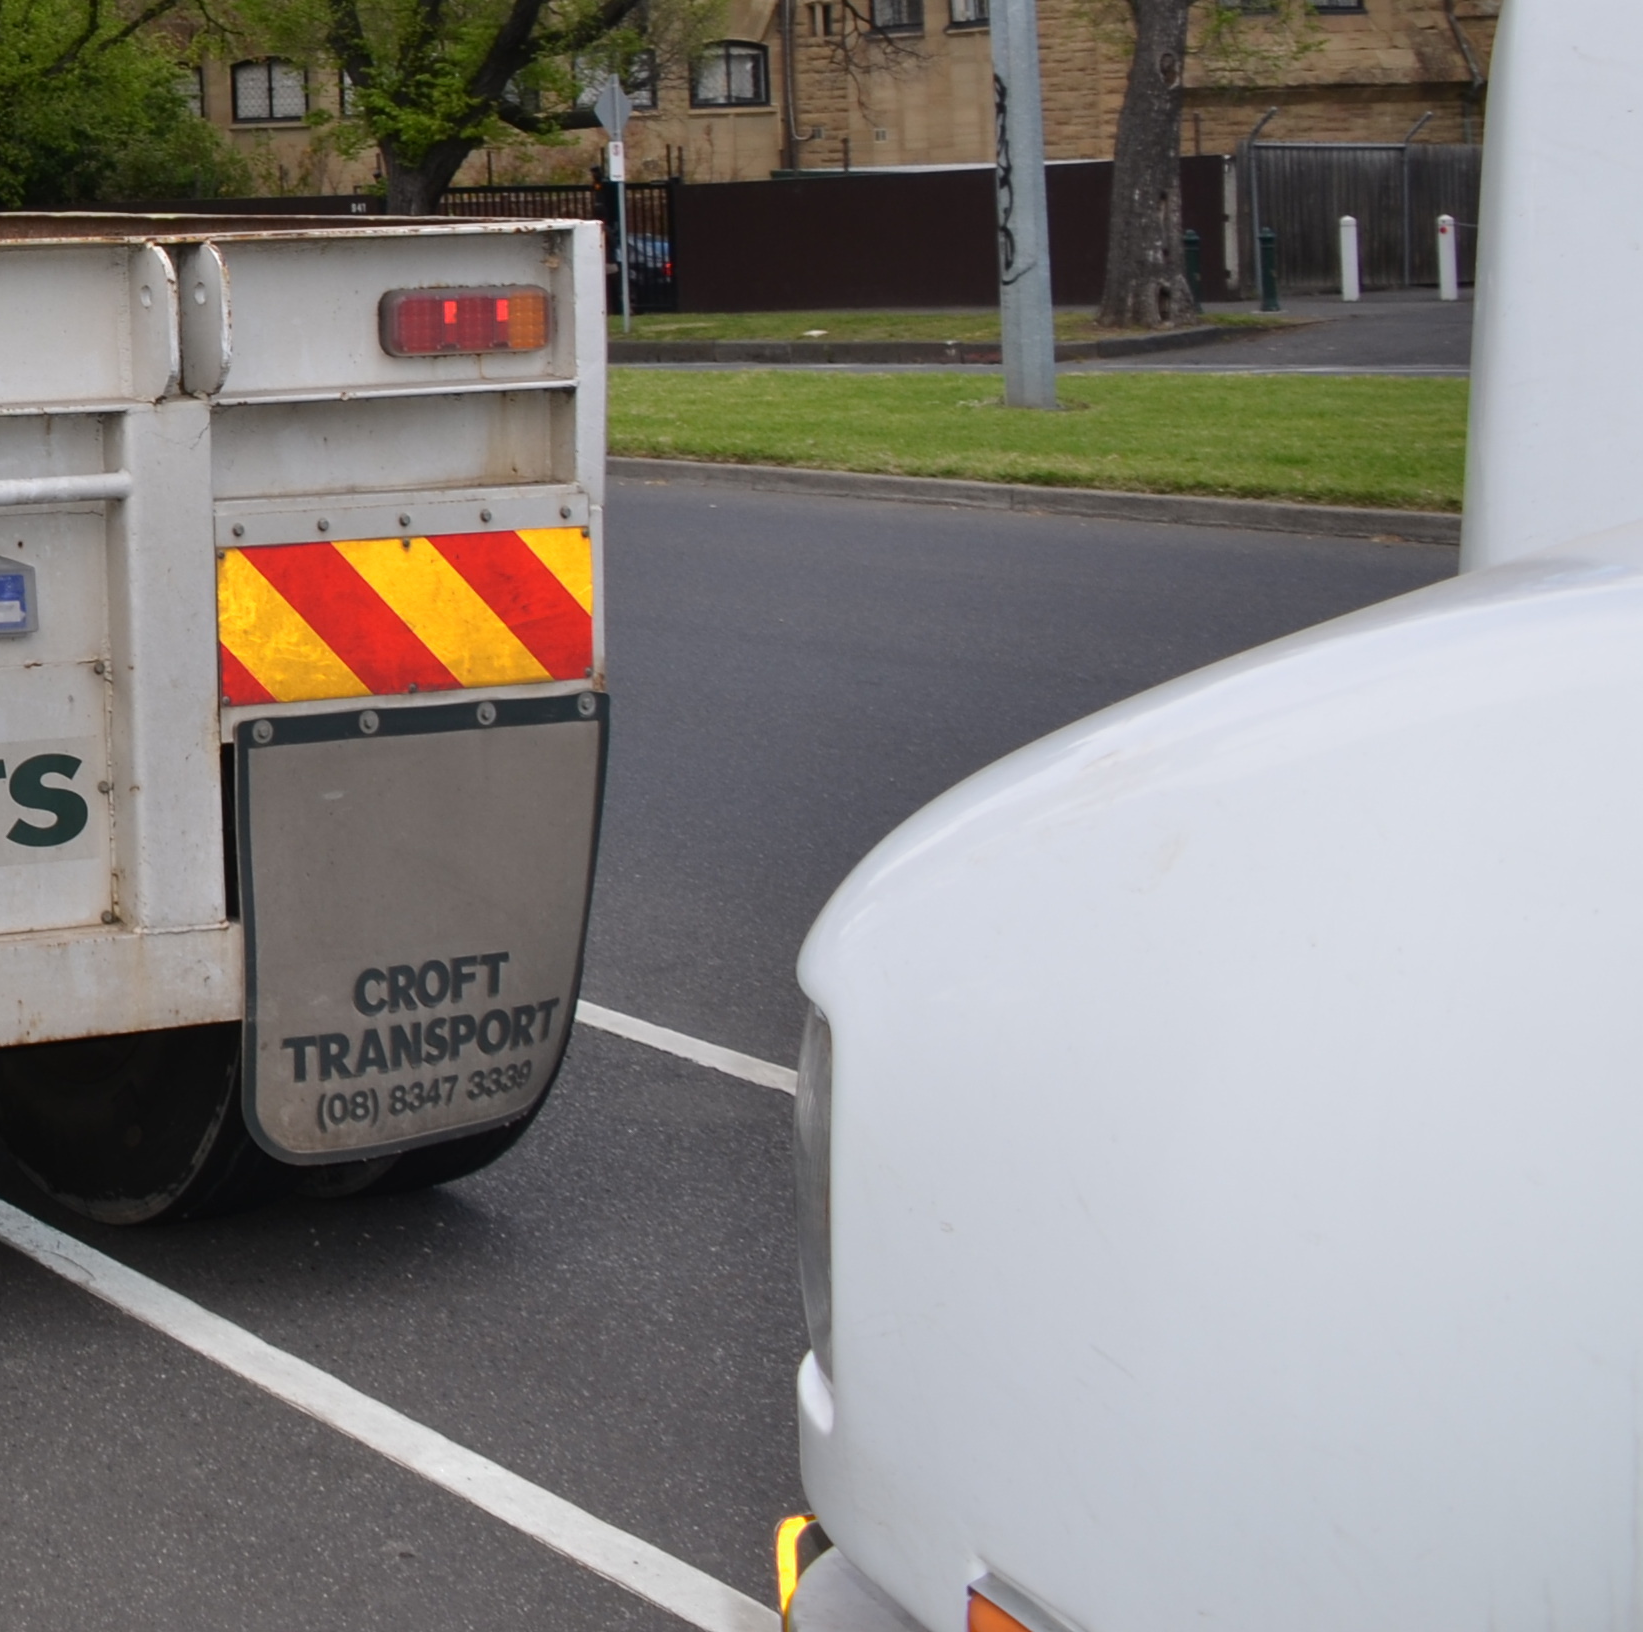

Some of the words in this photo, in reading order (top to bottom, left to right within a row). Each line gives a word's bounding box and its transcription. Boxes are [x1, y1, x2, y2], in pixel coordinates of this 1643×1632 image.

[353, 951, 510, 1017] CROFT
[281, 998, 561, 1083] TRANSPORT
[316, 1088, 380, 1134] (08)
[387, 1074, 459, 1118] 8347
[465, 1059, 533, 1103] 3339
